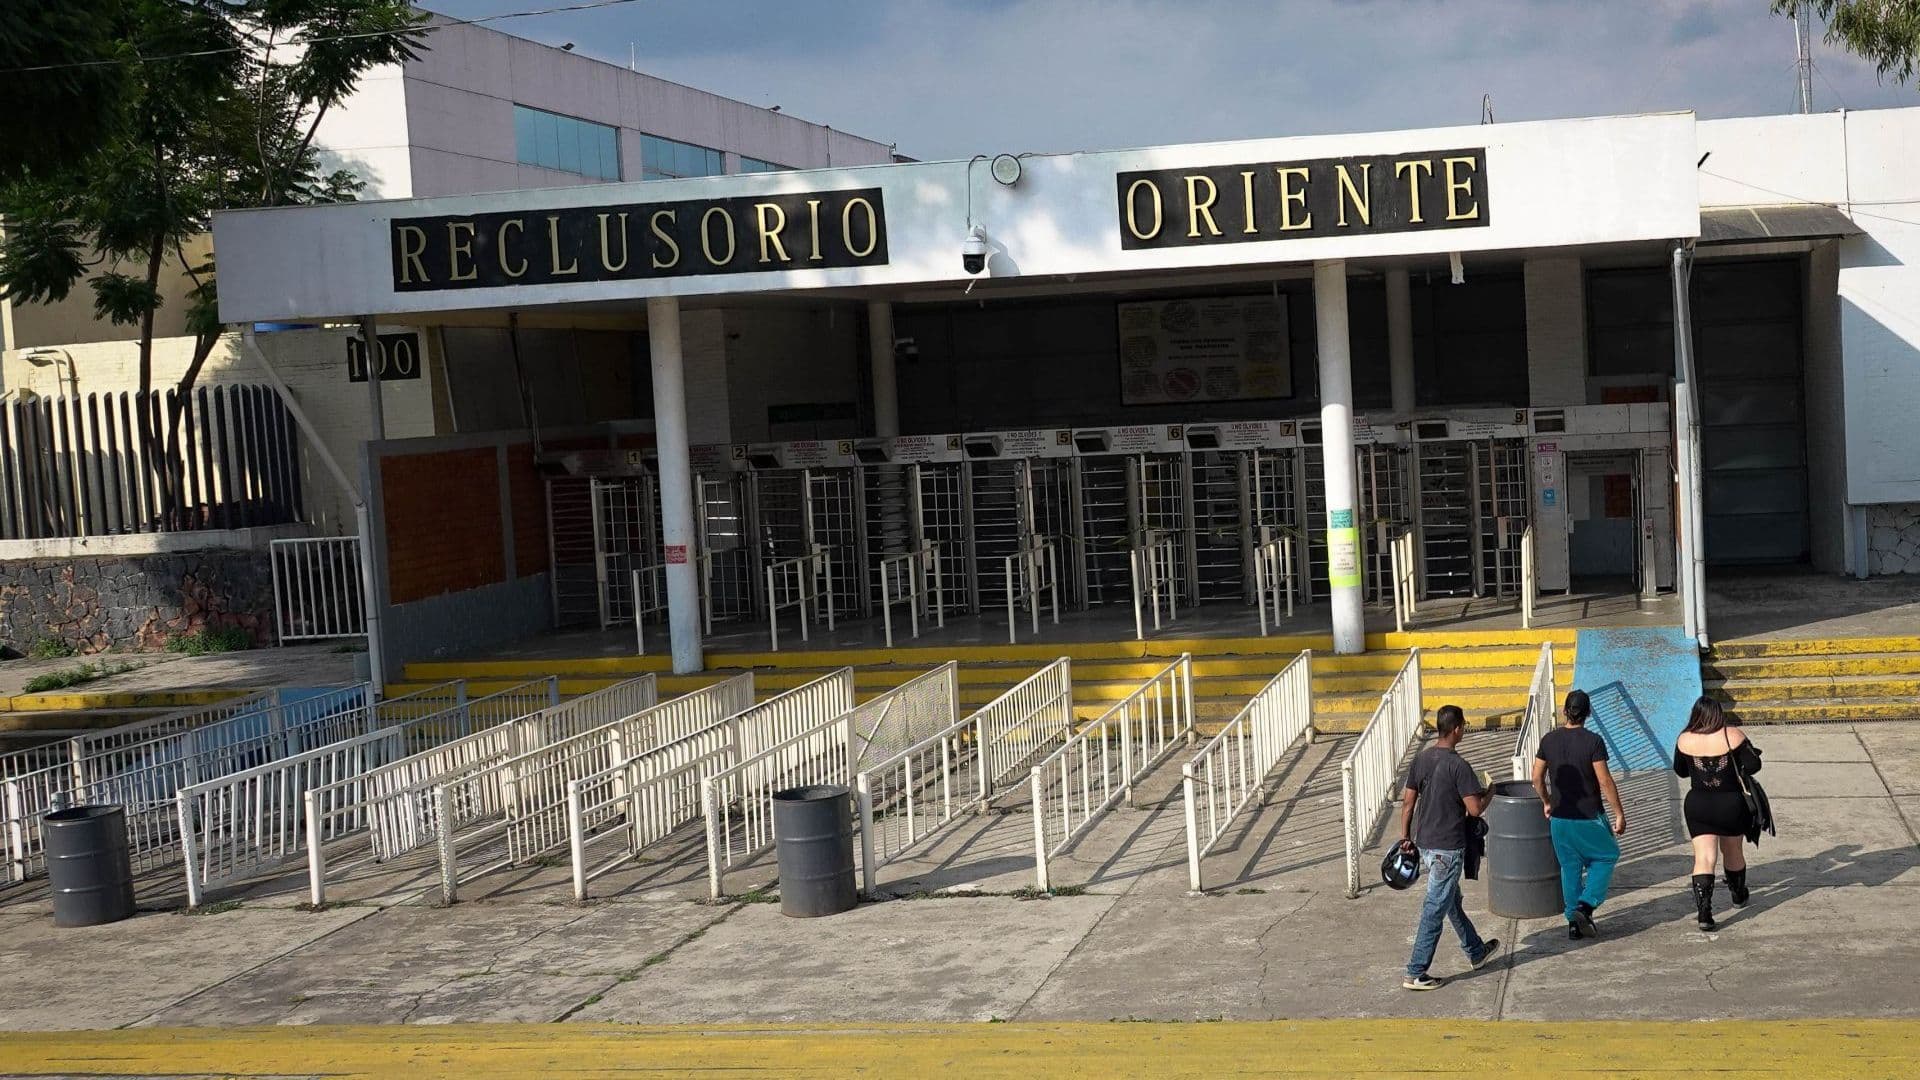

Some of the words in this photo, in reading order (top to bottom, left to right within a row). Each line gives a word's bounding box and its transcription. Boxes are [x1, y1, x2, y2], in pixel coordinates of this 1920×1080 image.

[397, 197, 878, 283] RECLUSORIO
[1126, 156, 1479, 241] ORIENTE
[1515, 412, 1524, 423] 9
[1171, 428, 1180, 438] 6
[1283, 424, 1293, 434] 7
[950, 438, 959, 448] 4
[1060, 433, 1069, 443] 5
[735, 448, 744, 458] 2
[842, 443, 851, 453] 3
